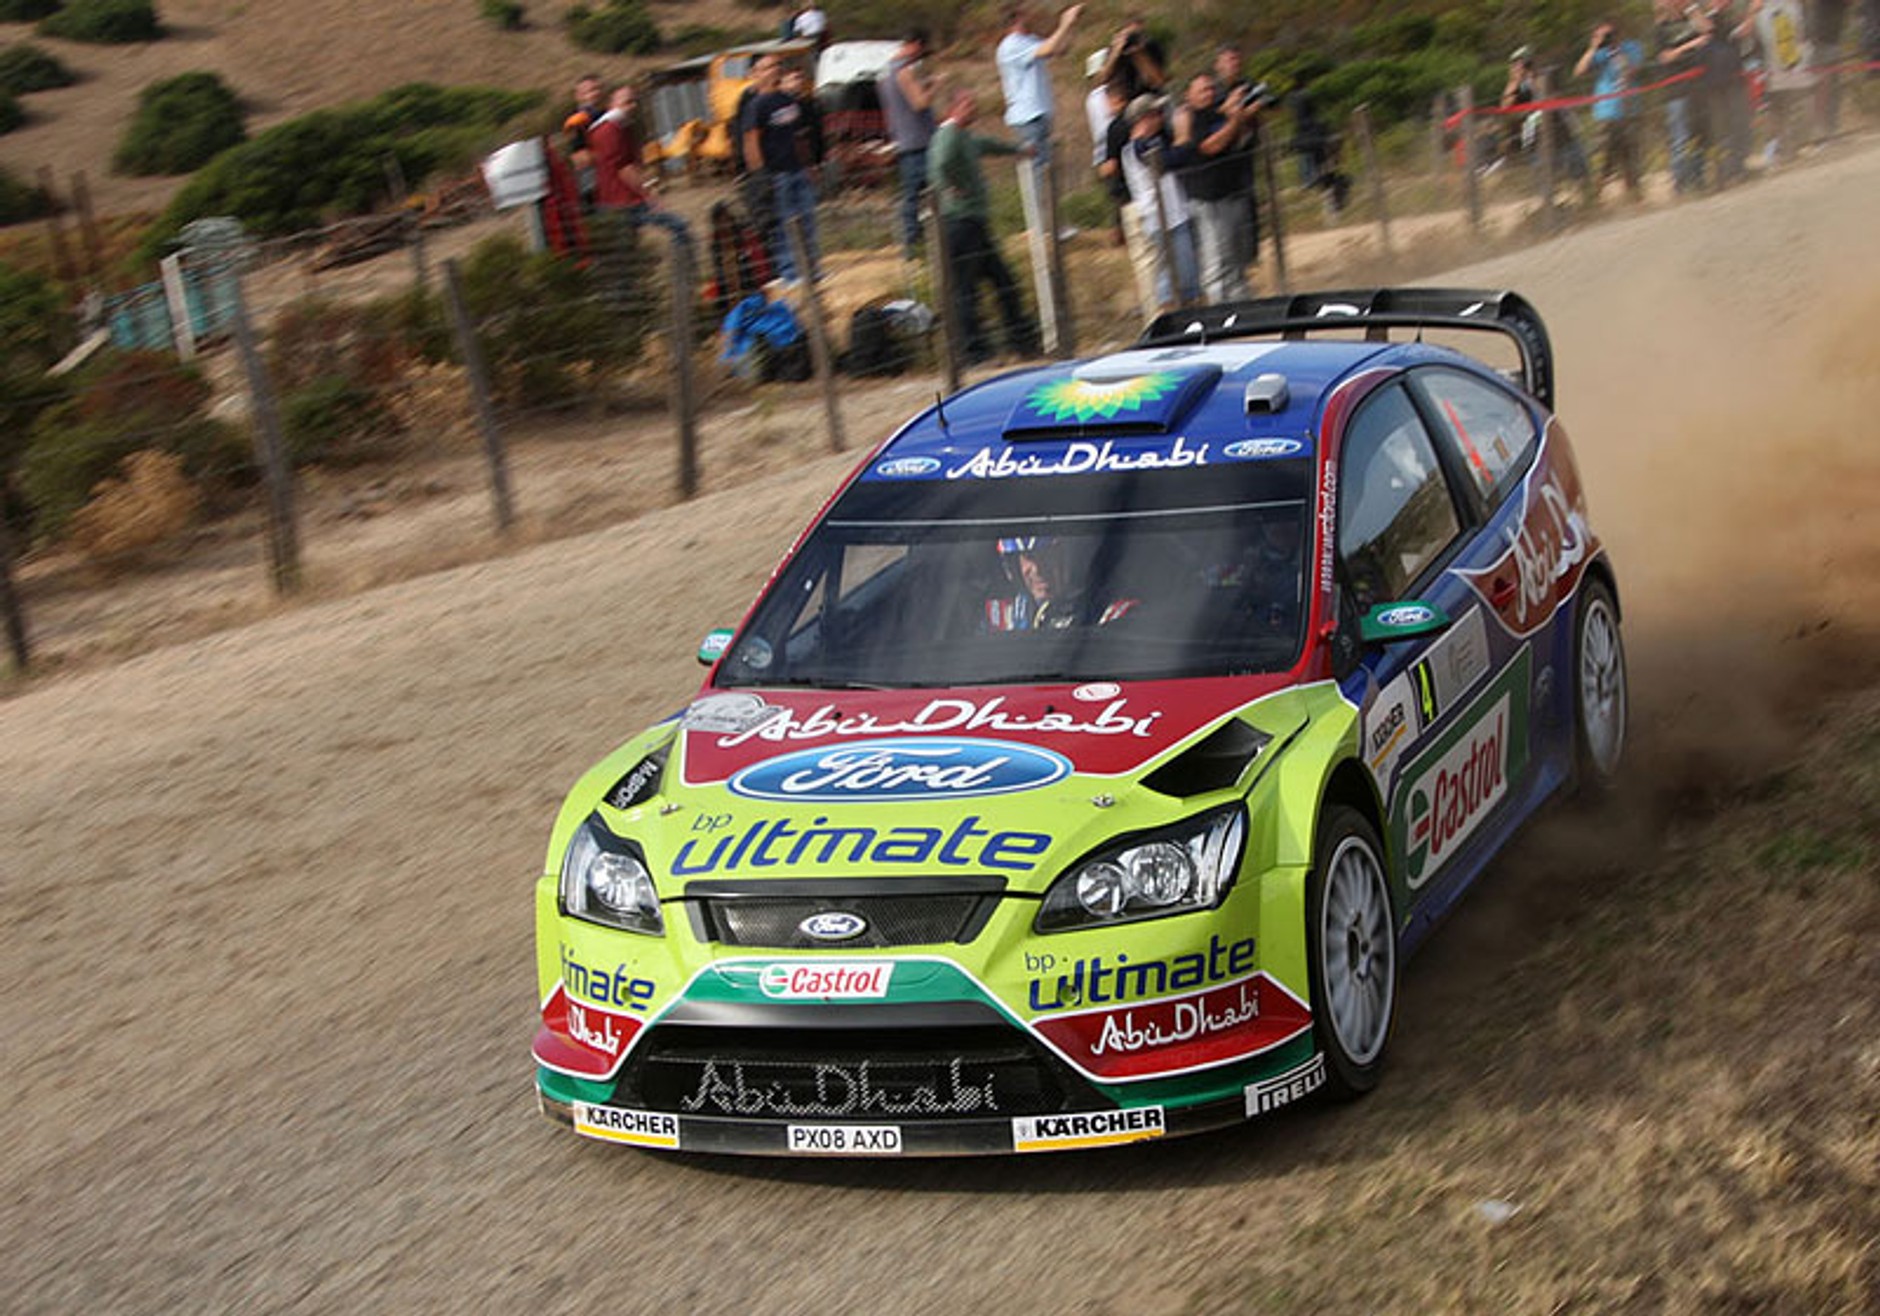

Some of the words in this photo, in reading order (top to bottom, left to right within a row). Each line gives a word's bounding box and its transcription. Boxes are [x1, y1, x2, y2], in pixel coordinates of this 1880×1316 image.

[1417, 661, 1434, 723] 4
[781, 745, 1011, 793] Ford
[1430, 712, 1504, 855] Castrol
[670, 816, 1053, 875] ultimate
[691, 813, 733, 833] bp
[790, 966, 881, 995] Castrol
[1025, 952, 1056, 973] bp
[1029, 934, 1256, 1012] ultimate
[1244, 1051, 1326, 1118] PIRELLI
[793, 1128, 846, 1149] PX08
[852, 1129, 899, 1149] AXD
[1035, 1109, 1162, 1138] KÄRCHER
